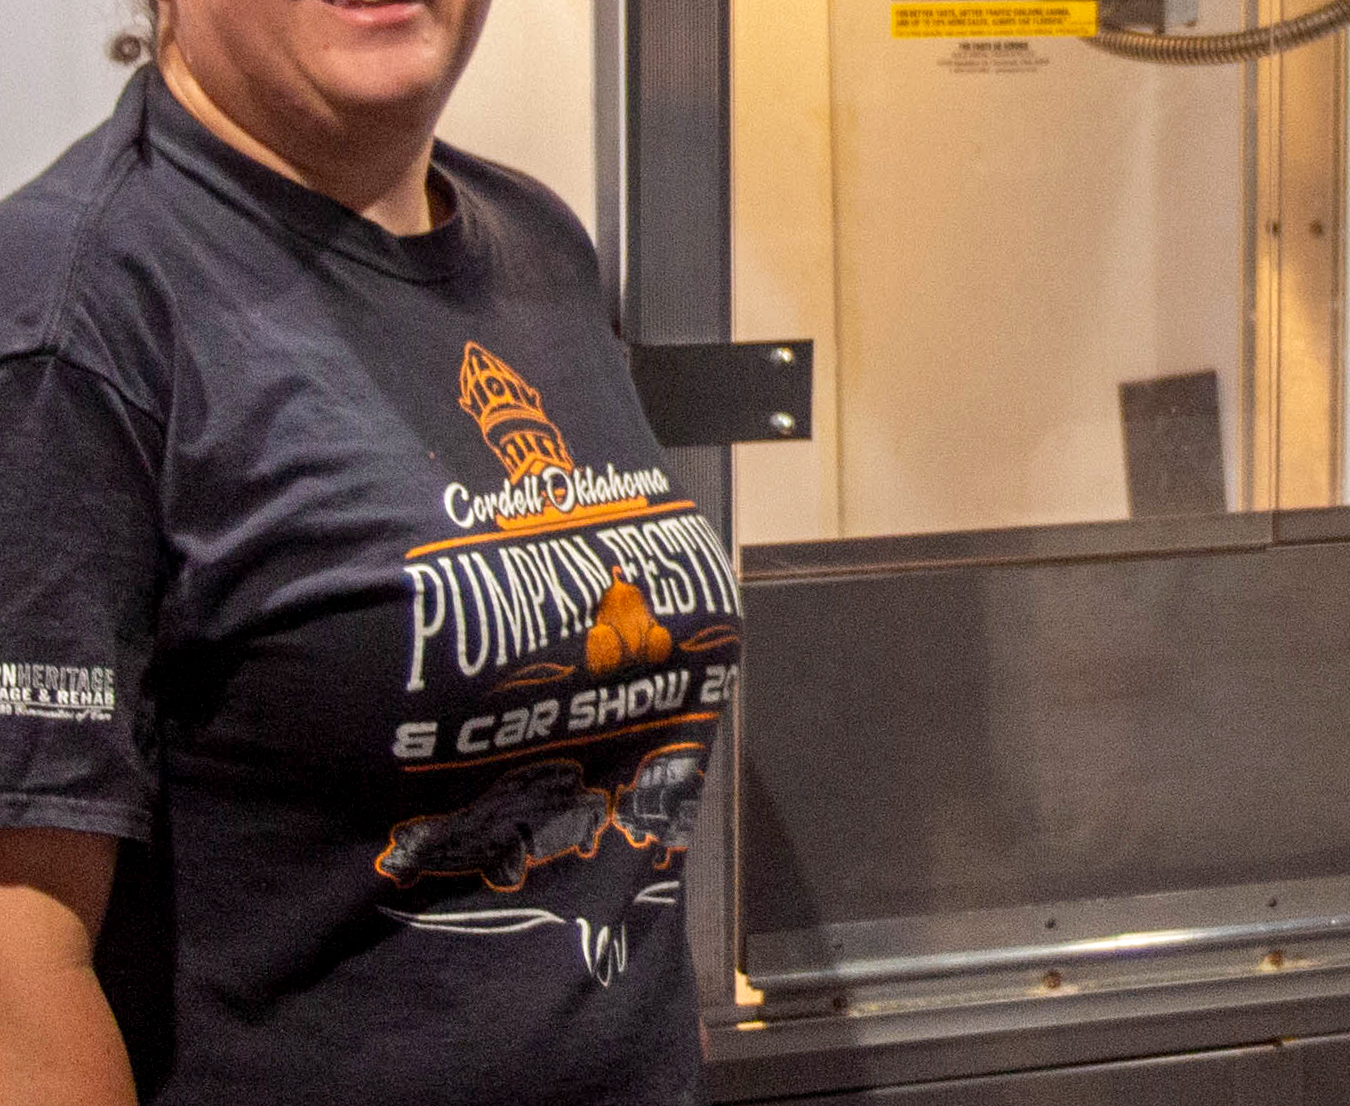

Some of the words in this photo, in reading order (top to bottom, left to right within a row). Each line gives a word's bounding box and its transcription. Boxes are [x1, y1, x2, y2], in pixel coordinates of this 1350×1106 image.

[443, 474, 542, 530] Cordell
[541, 462, 670, 514] Oklahoma
[404, 534, 613, 692] PUMPKIN
[56, 689, 115, 706] REHAB
[392, 721, 438, 758] &
[456, 699, 561, 754] CAR
[567, 670, 690, 732] SHOW
